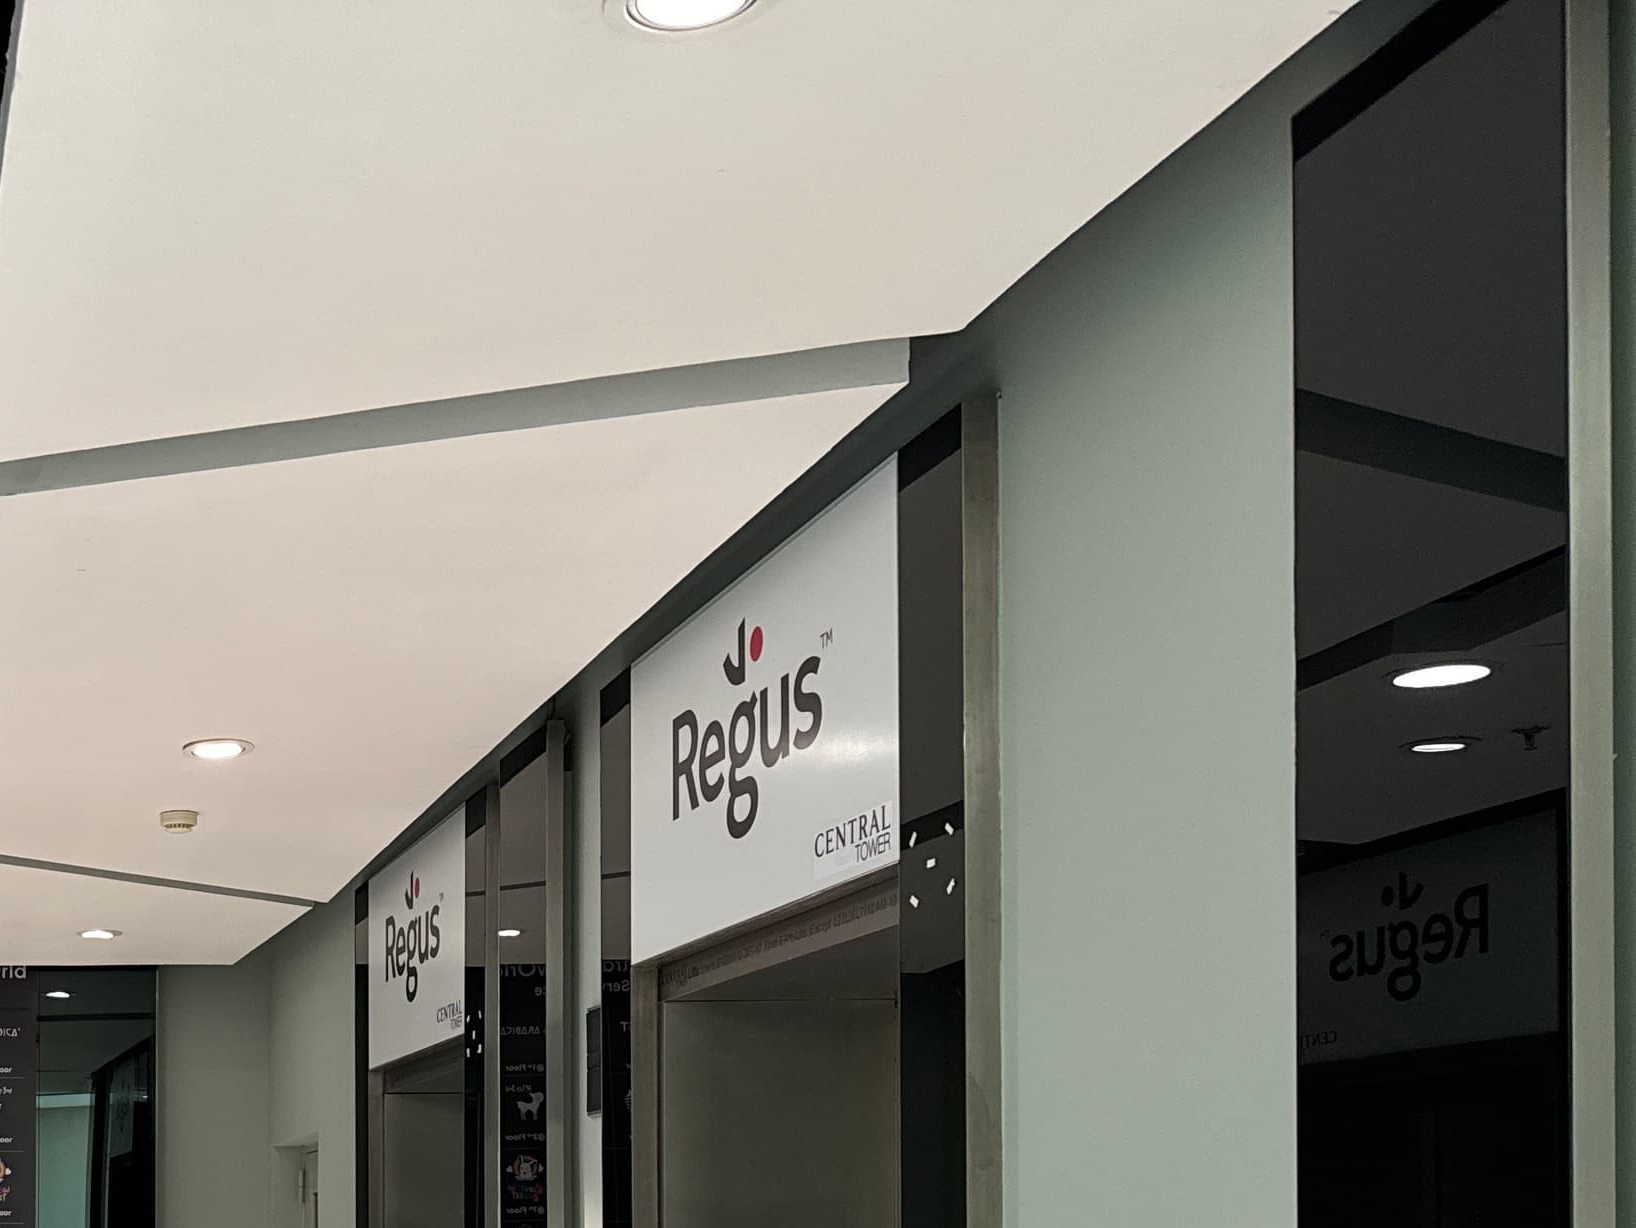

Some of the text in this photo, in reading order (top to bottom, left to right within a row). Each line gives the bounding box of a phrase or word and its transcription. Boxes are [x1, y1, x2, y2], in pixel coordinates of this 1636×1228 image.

[672, 655, 823, 839] Regus
[813, 805, 891, 858] CENTRAL
[855, 831, 891, 864] TOWER
[385, 905, 440, 1003] Regus
[436, 1001, 462, 1024] CENTRAL
